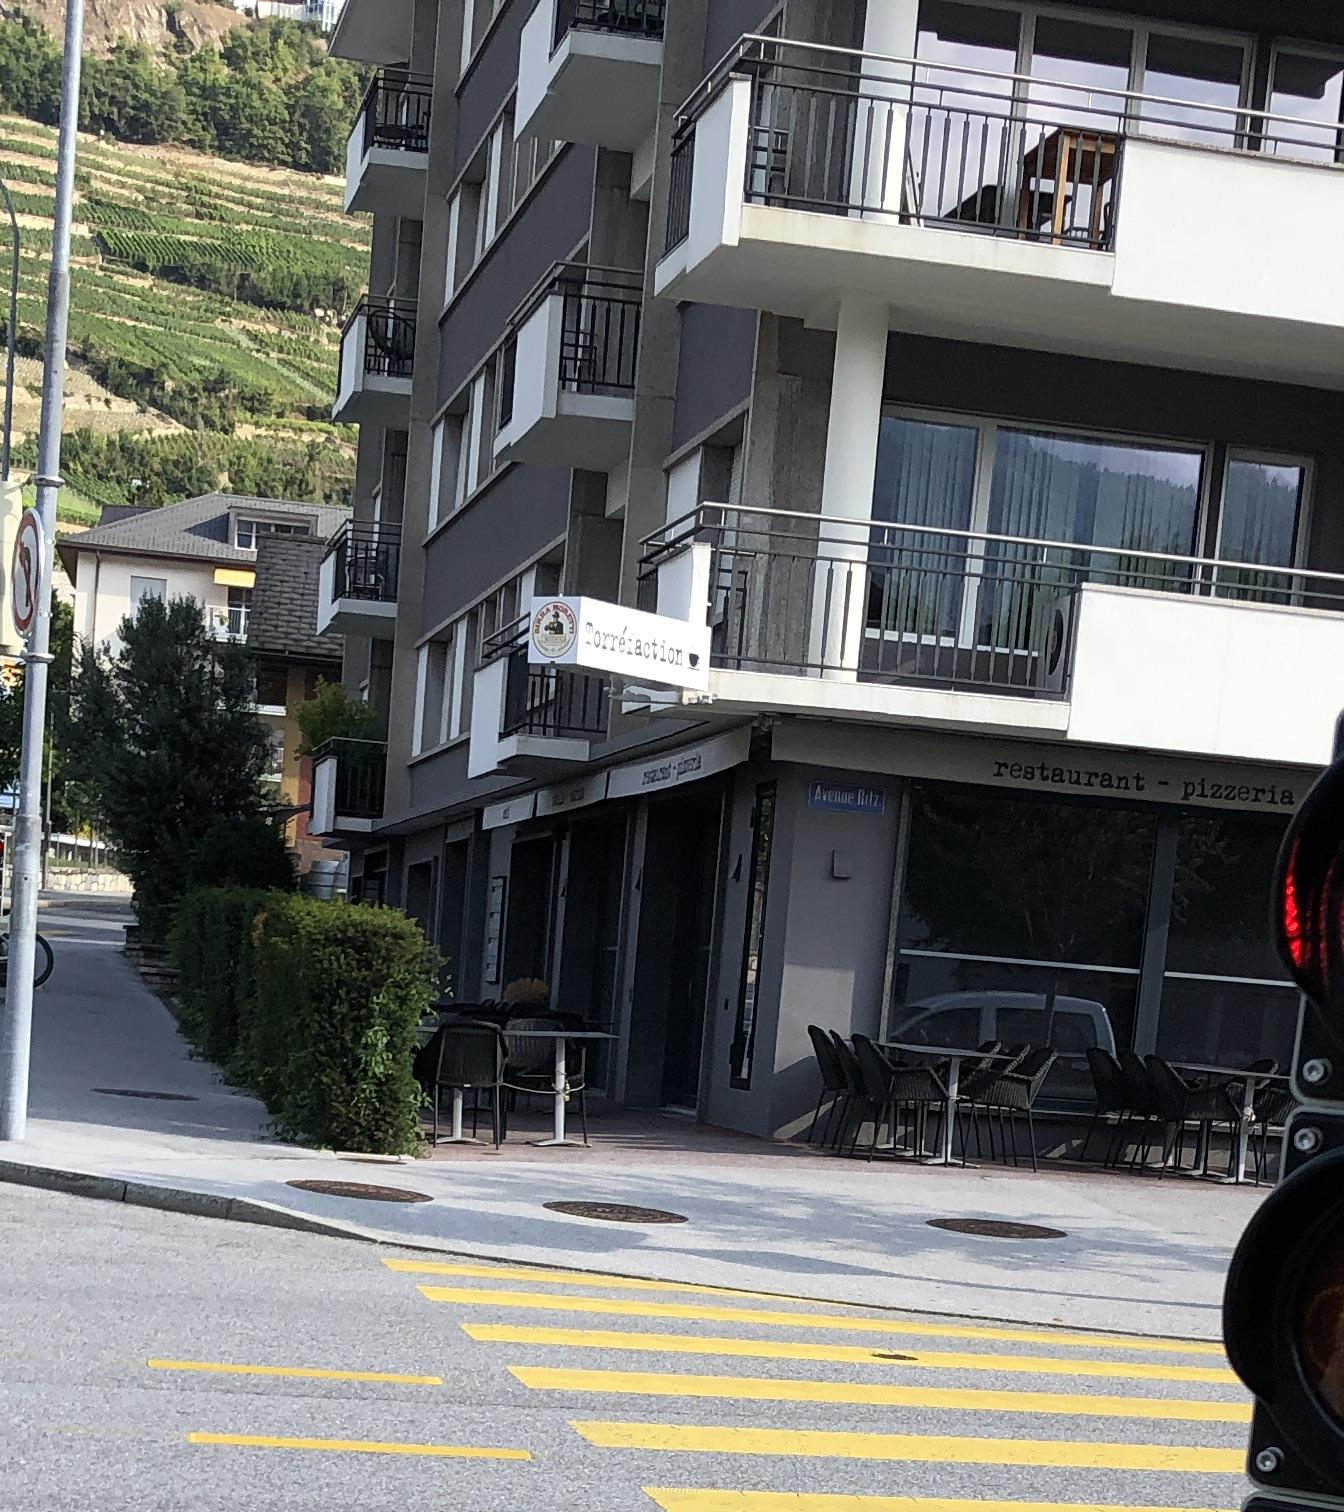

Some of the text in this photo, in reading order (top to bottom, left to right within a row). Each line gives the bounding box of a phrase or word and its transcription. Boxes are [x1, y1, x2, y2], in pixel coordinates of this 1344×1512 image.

[585, 621, 684, 666] Torréfaction
[814, 784, 881, 808] Avenue Ritz
[992, 759, 1146, 792] restaurant
[1182, 777, 1296, 807] pizzeria
